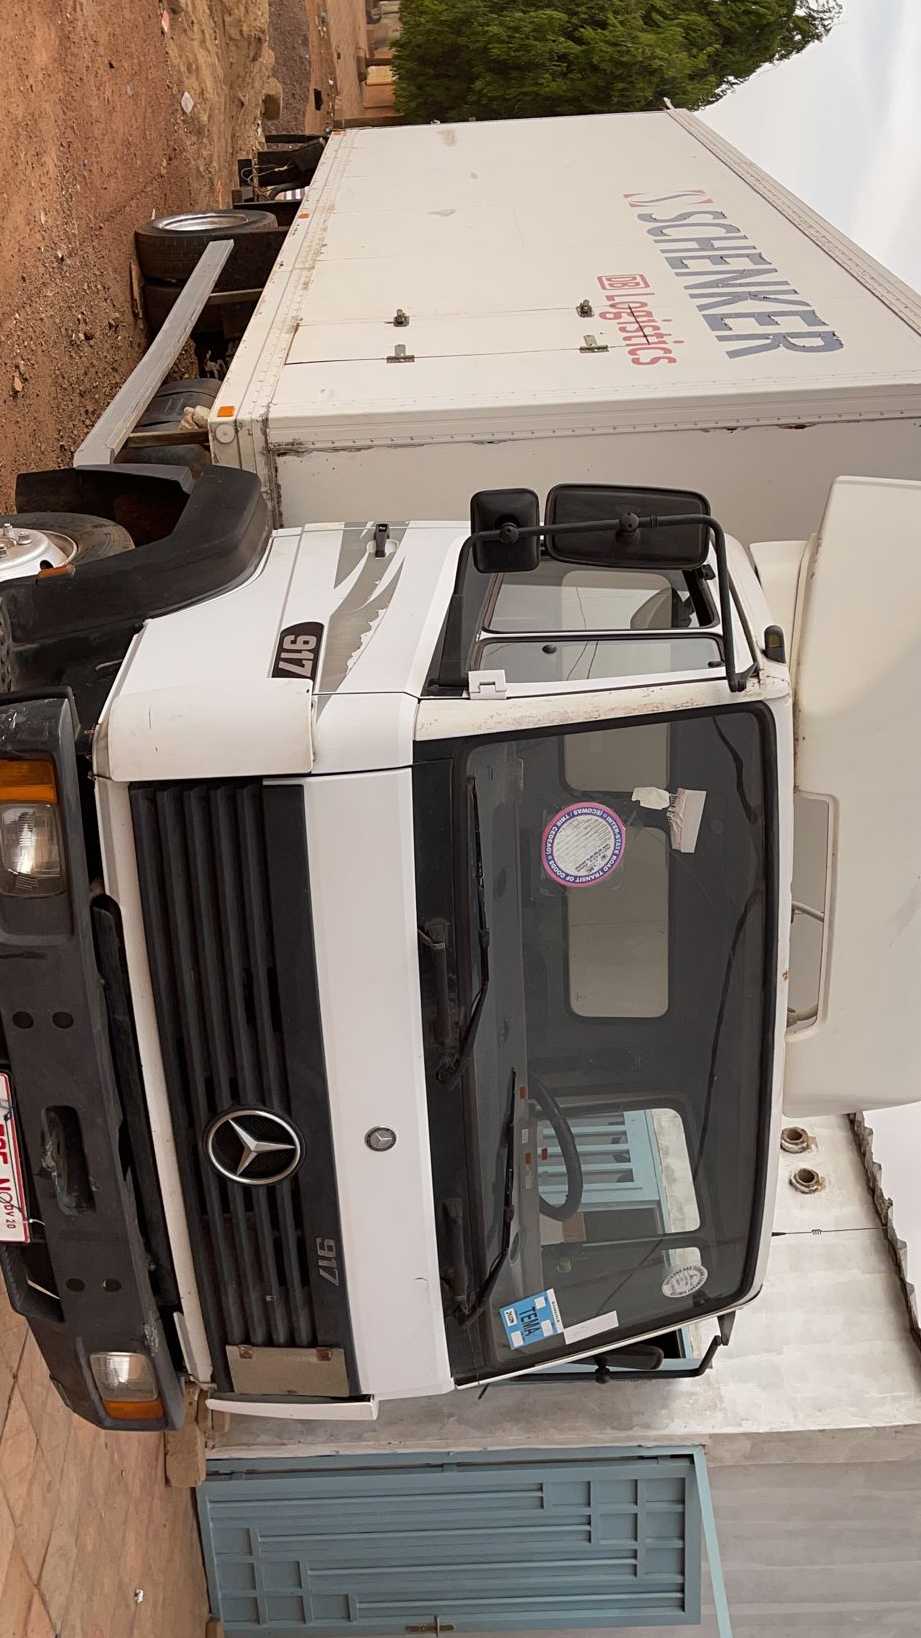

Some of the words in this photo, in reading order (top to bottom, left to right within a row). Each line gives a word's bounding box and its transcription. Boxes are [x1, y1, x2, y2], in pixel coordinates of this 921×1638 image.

[637, 210, 844, 359] SCHENKER
[599, 292, 685, 365] Logistics
[278, 634, 317, 677] 917
[603, 855, 617, 872] ROAD
[6, 1219, 16, 1229] 20
[315, 1237, 339, 1287] 917
[519, 1306, 541, 1337] TEMA
